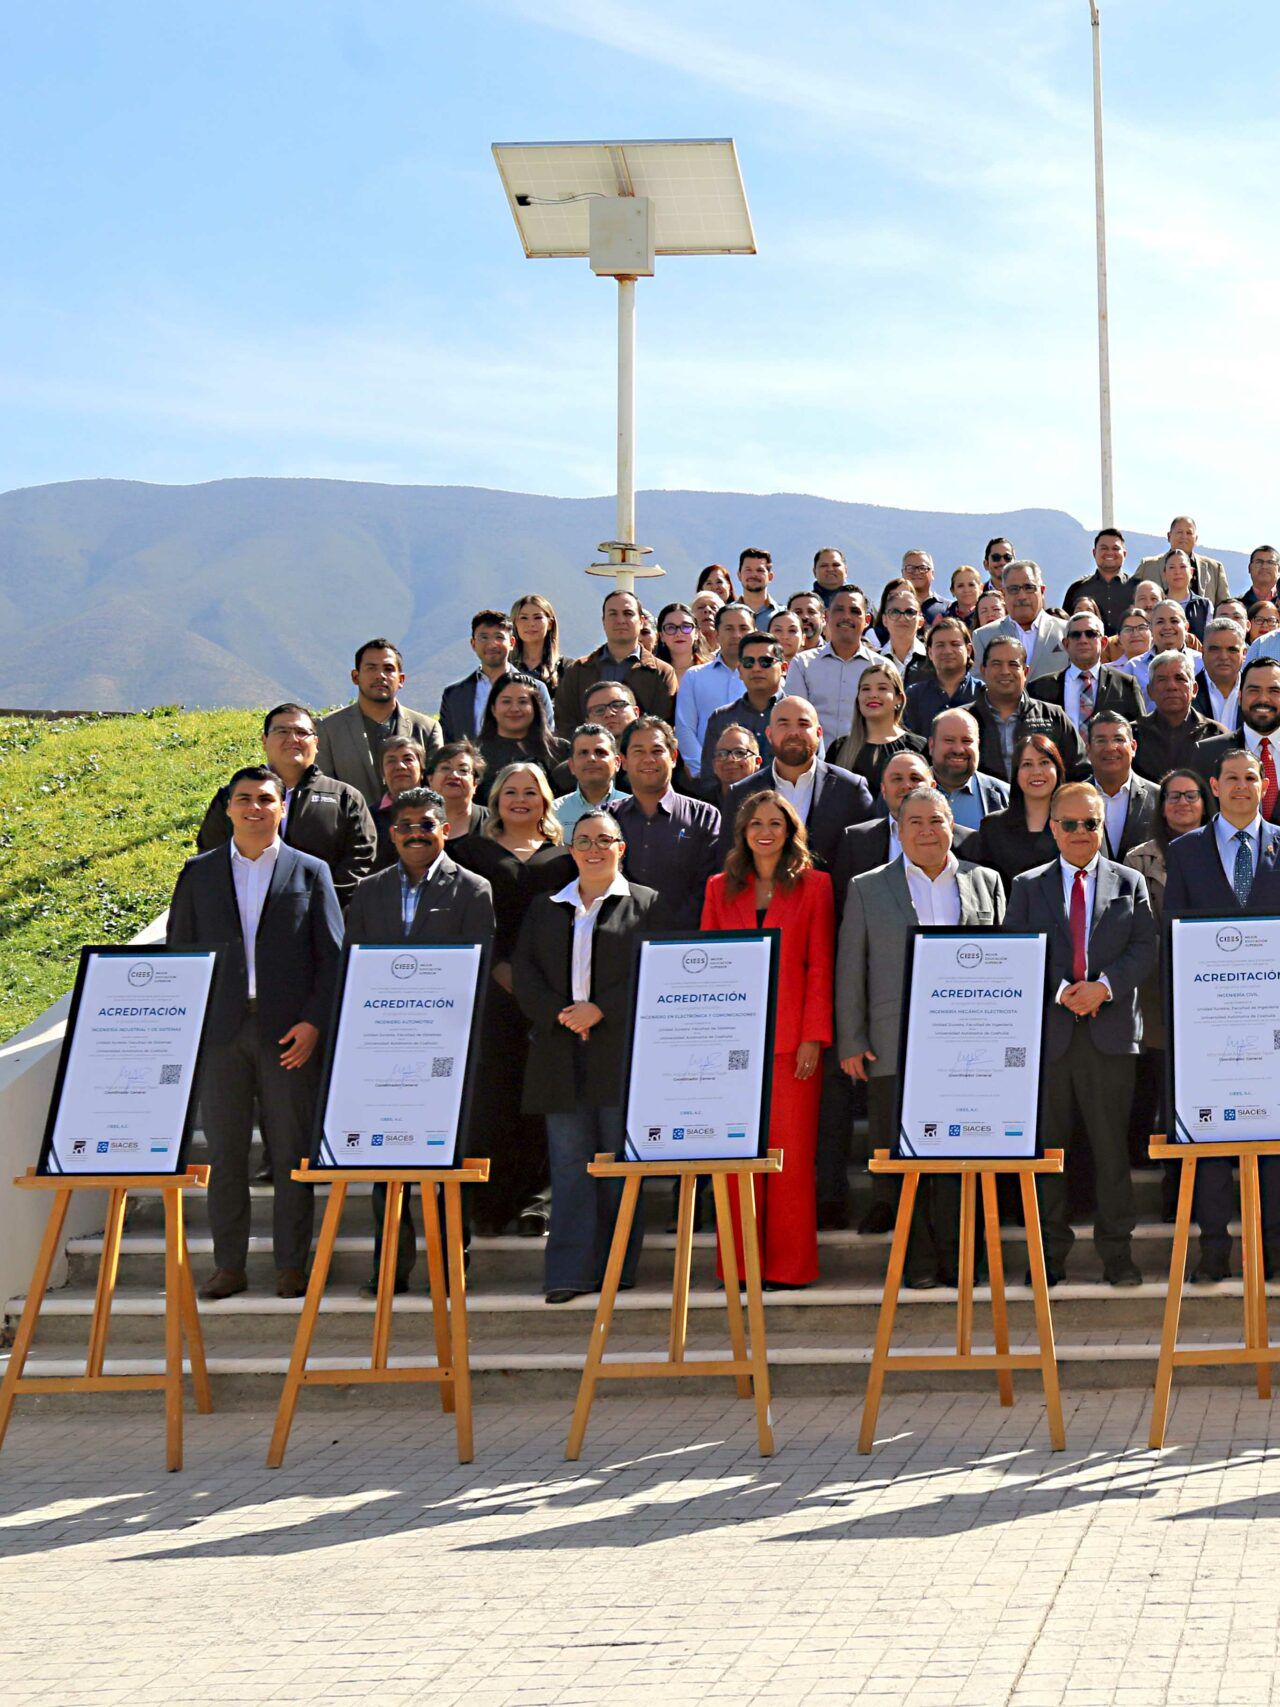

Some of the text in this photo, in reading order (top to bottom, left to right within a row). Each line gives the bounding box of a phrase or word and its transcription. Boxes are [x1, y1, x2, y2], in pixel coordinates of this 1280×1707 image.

[657, 990, 746, 1004] ACREDITACIÓN
[931, 988, 1022, 998] ACREDITACIÓN
[363, 997, 454, 1009] ACREDITACIÓN
[98, 1006, 187, 1016] ACREDITACIÓN
